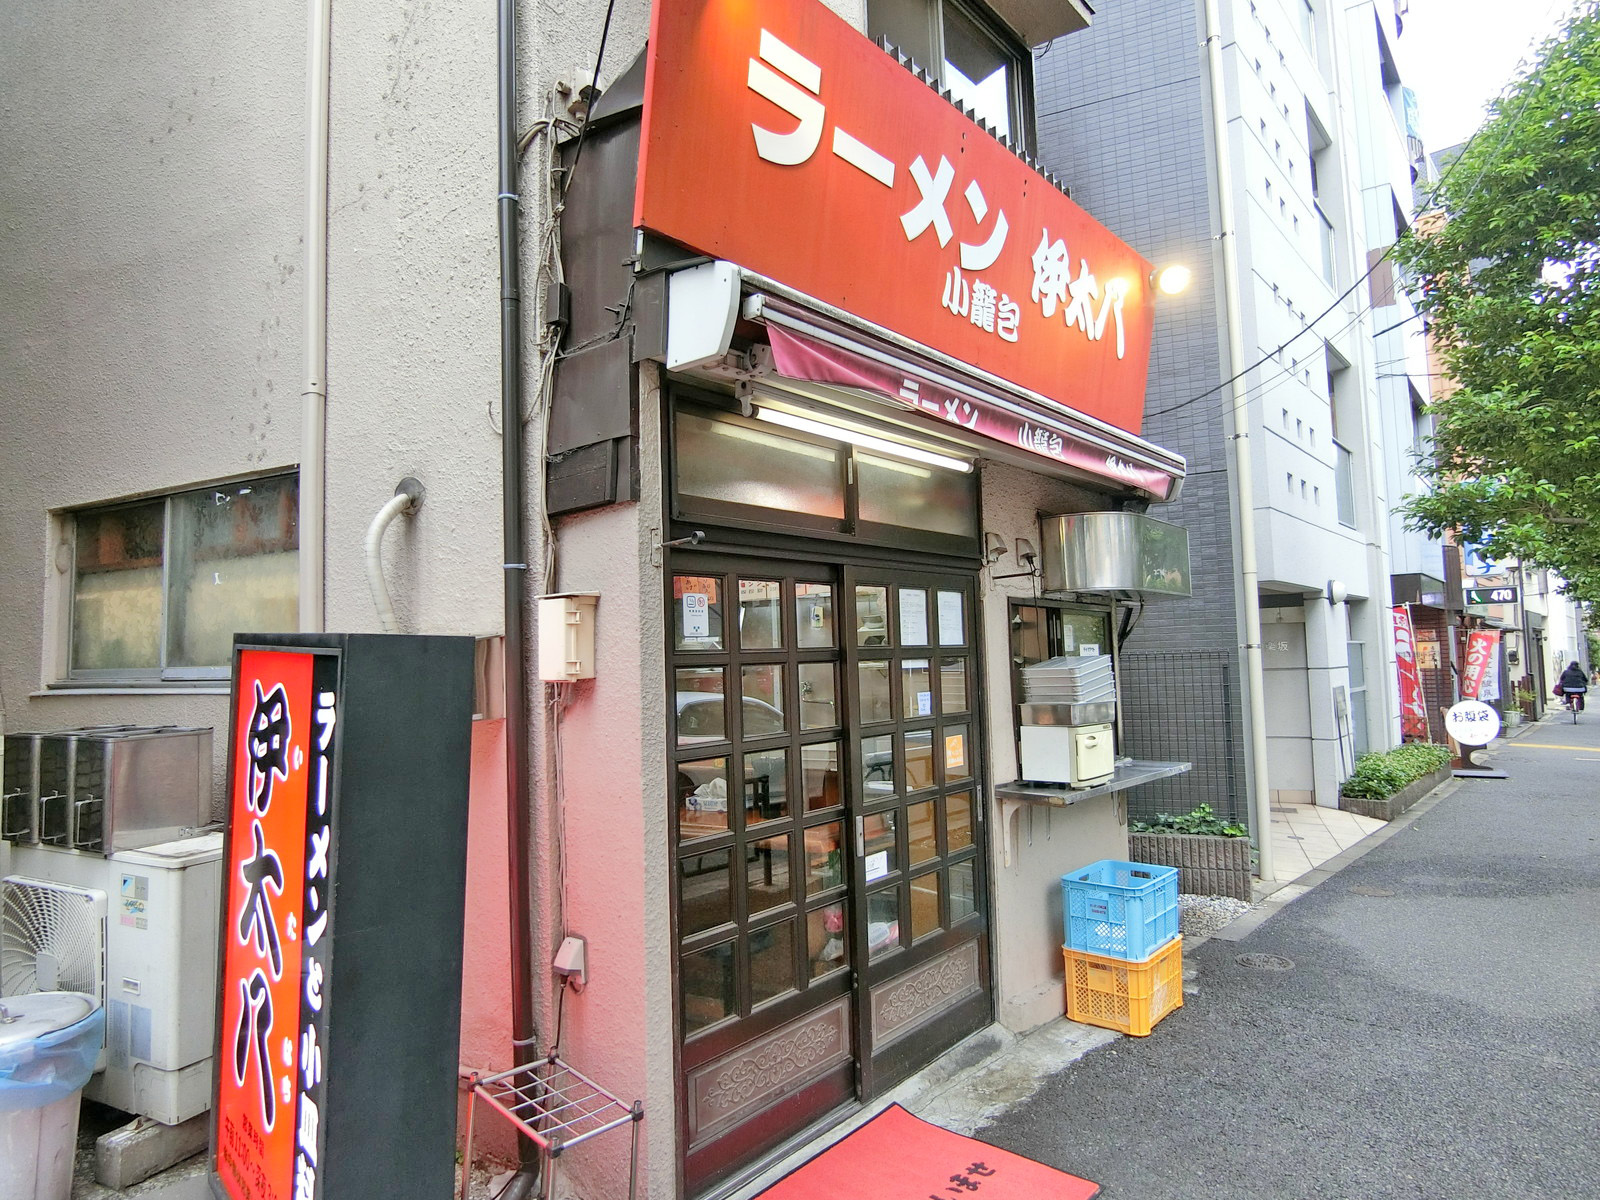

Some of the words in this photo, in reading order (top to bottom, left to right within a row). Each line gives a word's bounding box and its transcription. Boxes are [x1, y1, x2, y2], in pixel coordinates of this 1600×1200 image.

[747, 28, 1009, 272] ラーメン
[942, 266, 1020, 343] 小籠包
[899, 379, 978, 430] ラーメン
[1018, 422, 1065, 460] 小籠包
[1490, 589, 1513, 601] 470
[1463, 637, 1487, 694] 火の用心
